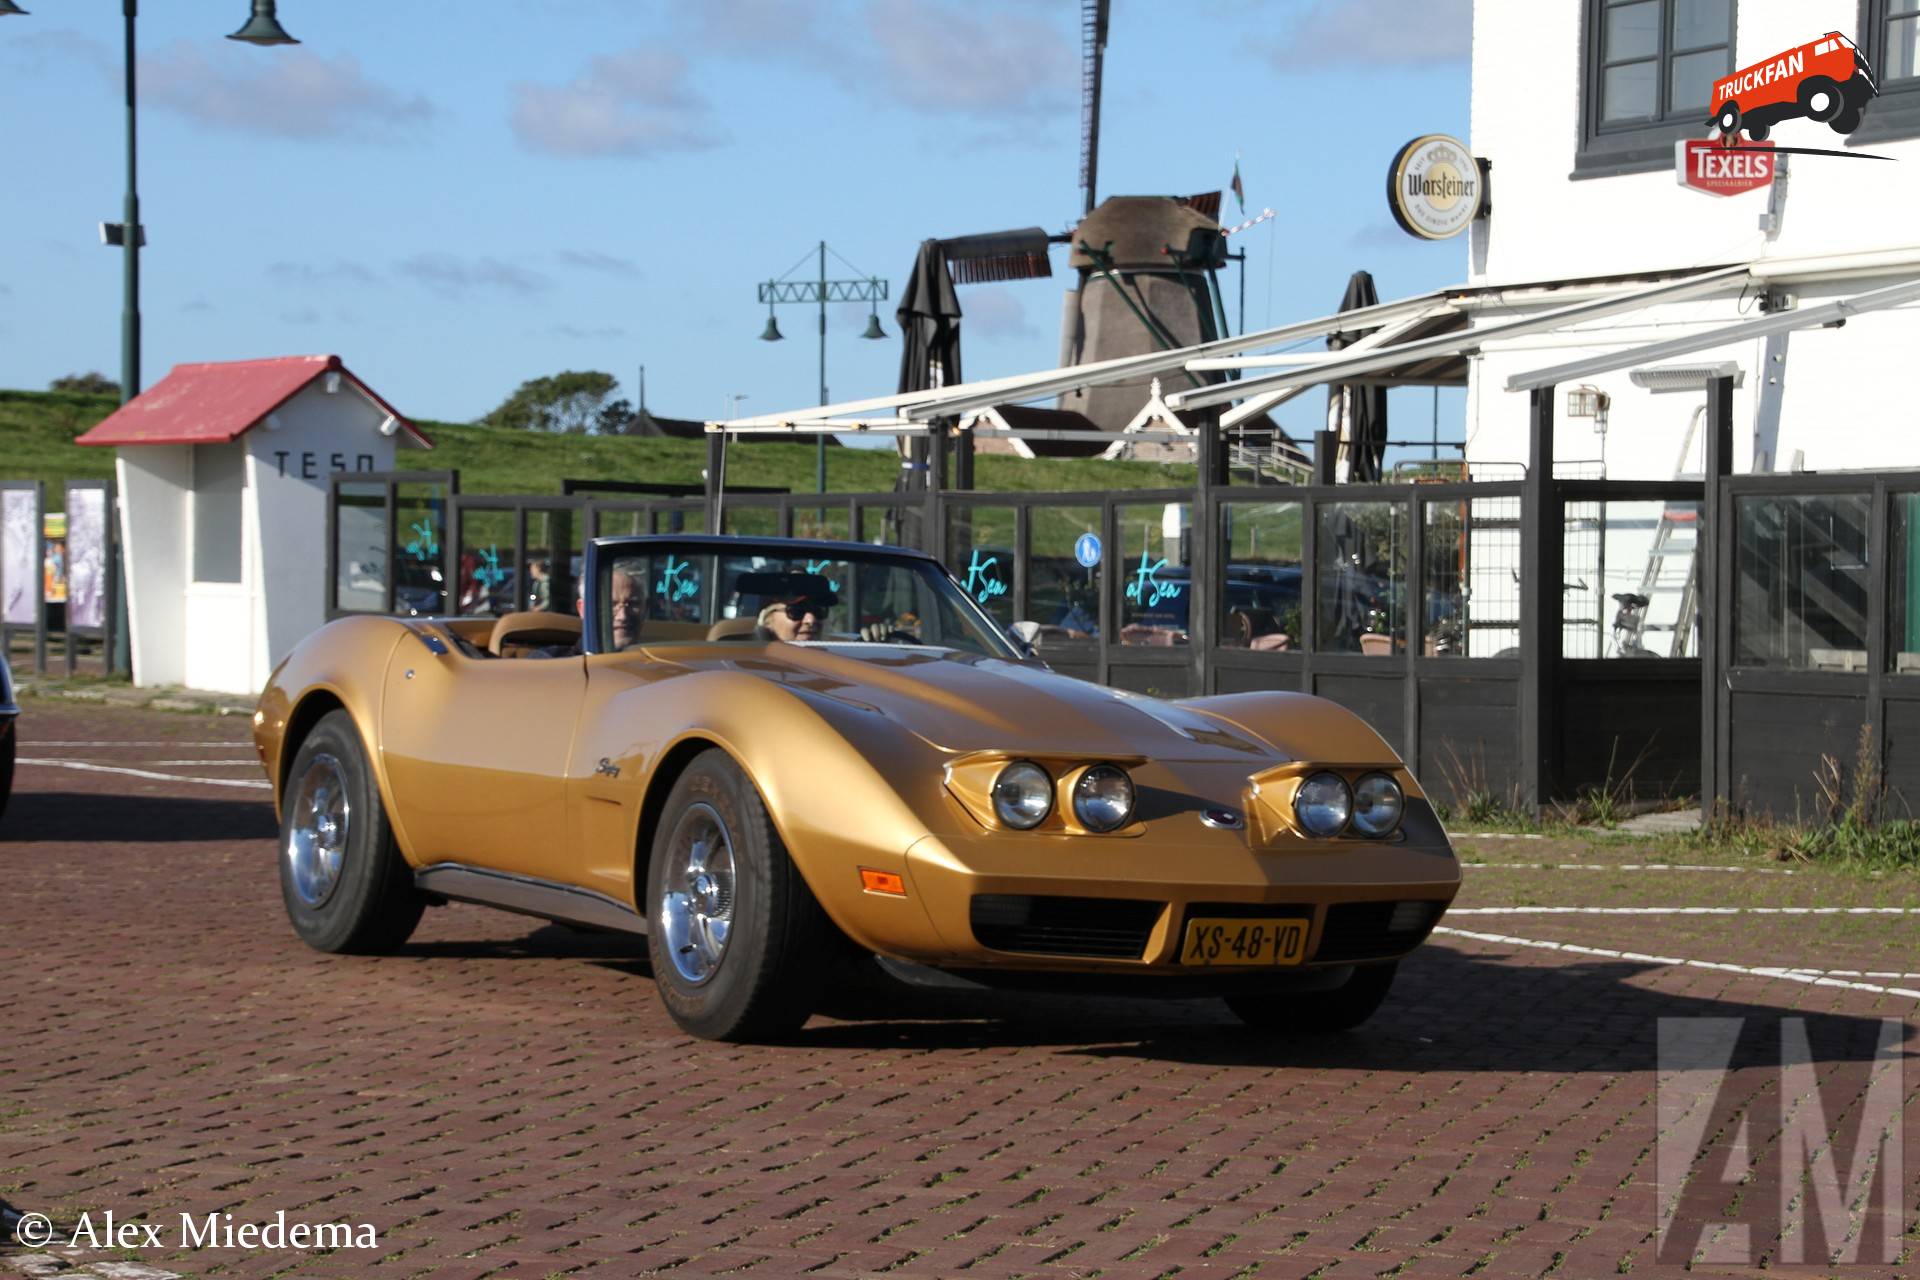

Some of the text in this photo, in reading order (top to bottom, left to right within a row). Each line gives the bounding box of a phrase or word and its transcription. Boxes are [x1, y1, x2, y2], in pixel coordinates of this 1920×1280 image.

[1690, 146, 1769, 178] TEXELS
[1408, 171, 1475, 199] Warsteiner
[274, 450, 374, 479] TESO
[1149, 558, 1181, 607] Sea
[1190, 926, 1301, 959] XS-48-VD
